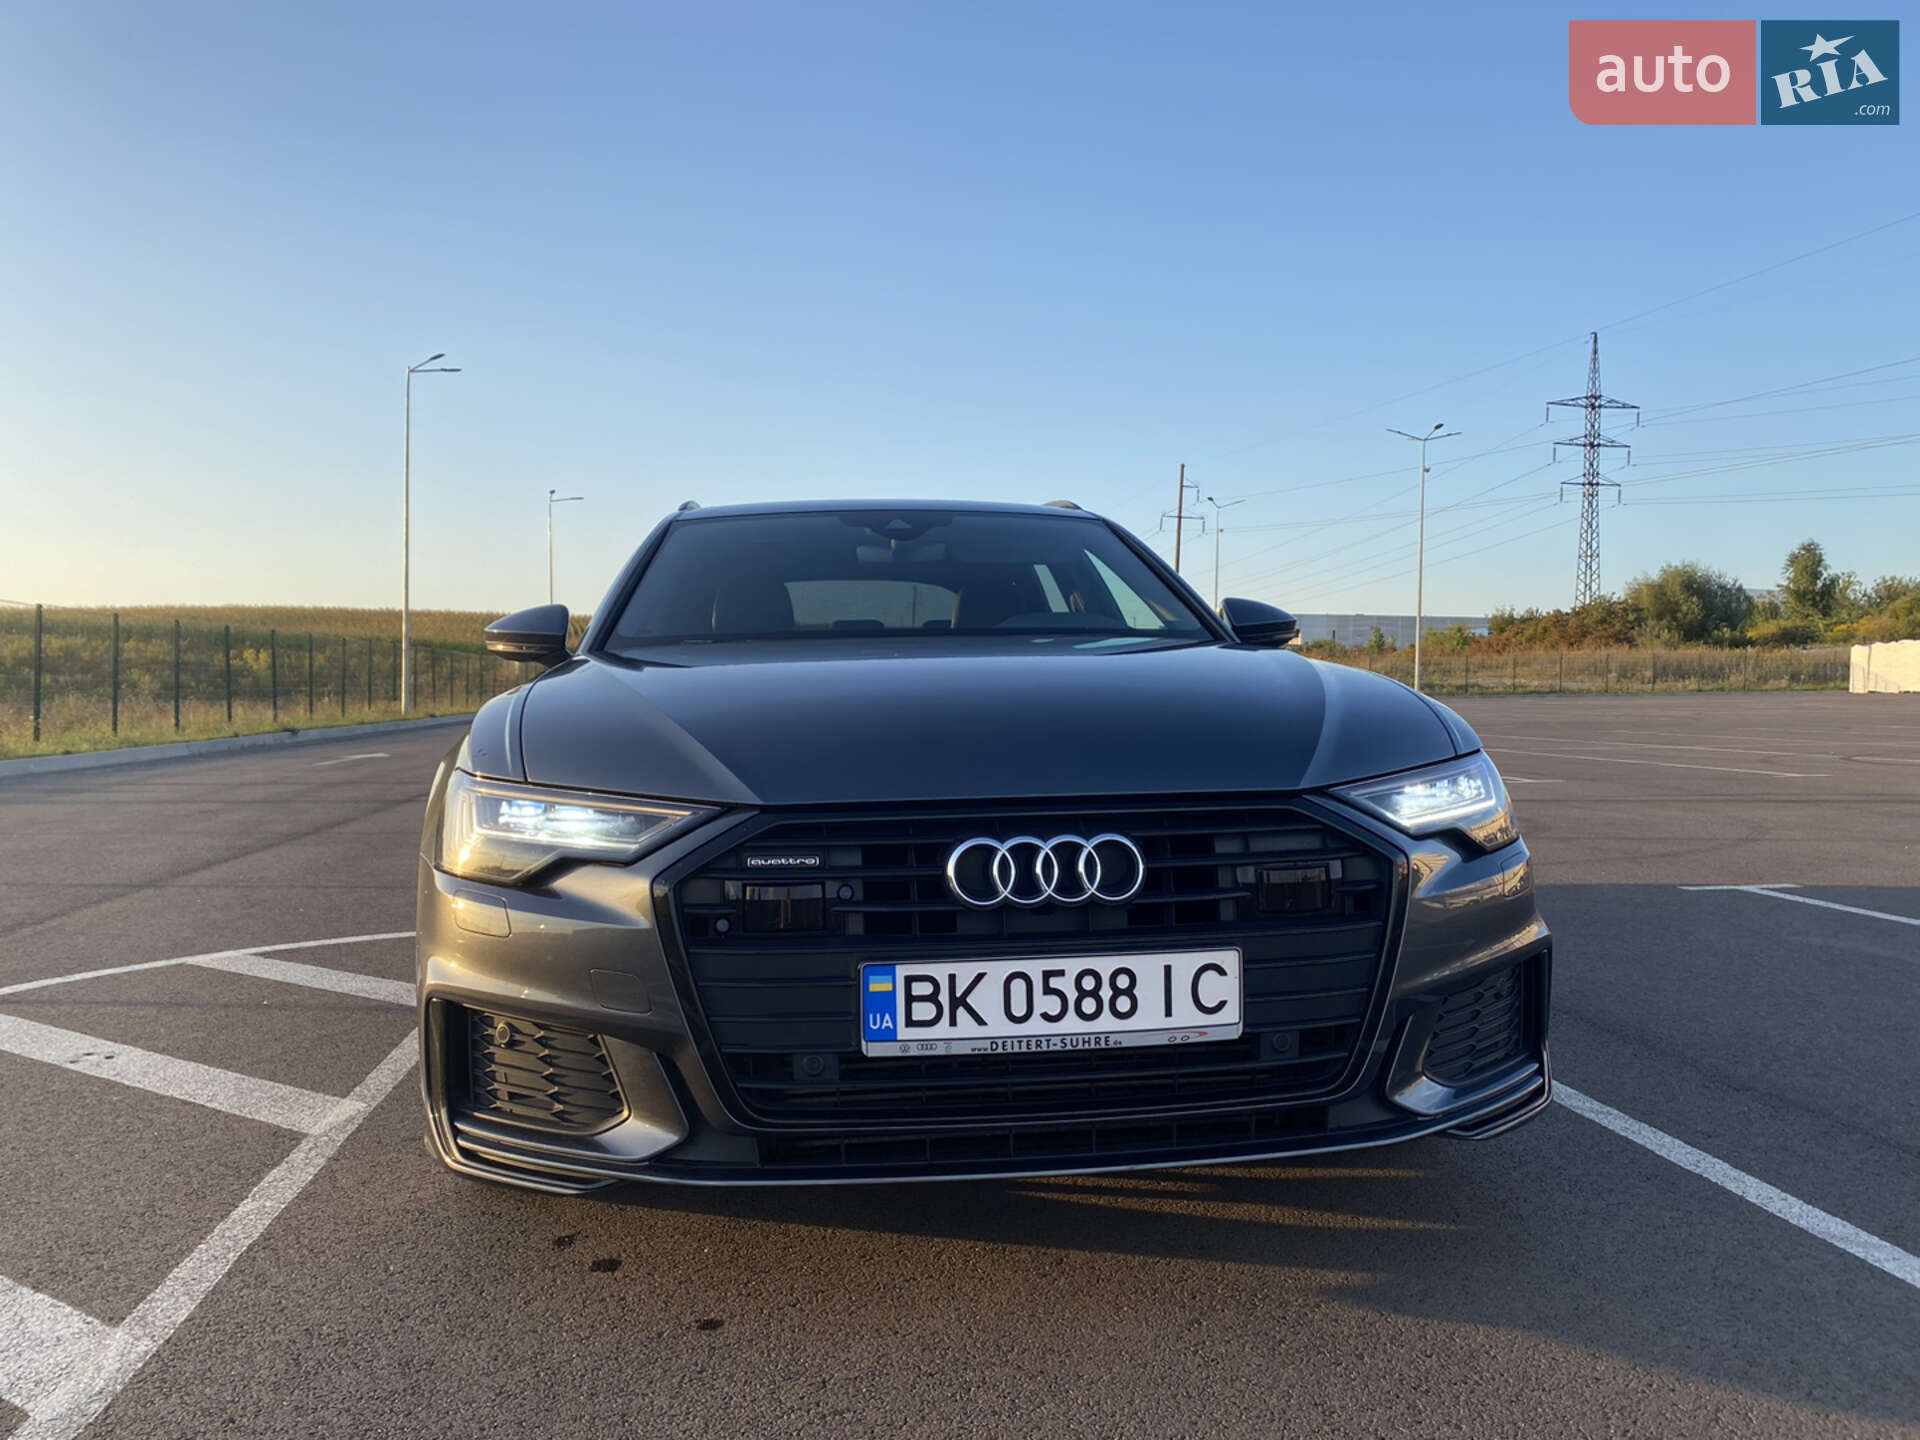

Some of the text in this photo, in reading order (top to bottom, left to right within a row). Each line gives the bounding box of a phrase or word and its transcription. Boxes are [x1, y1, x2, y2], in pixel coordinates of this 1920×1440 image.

[749, 857, 817, 867] quattro
[903, 963, 1229, 1028] BK 0588 IC
[869, 1013, 894, 1030] UA
